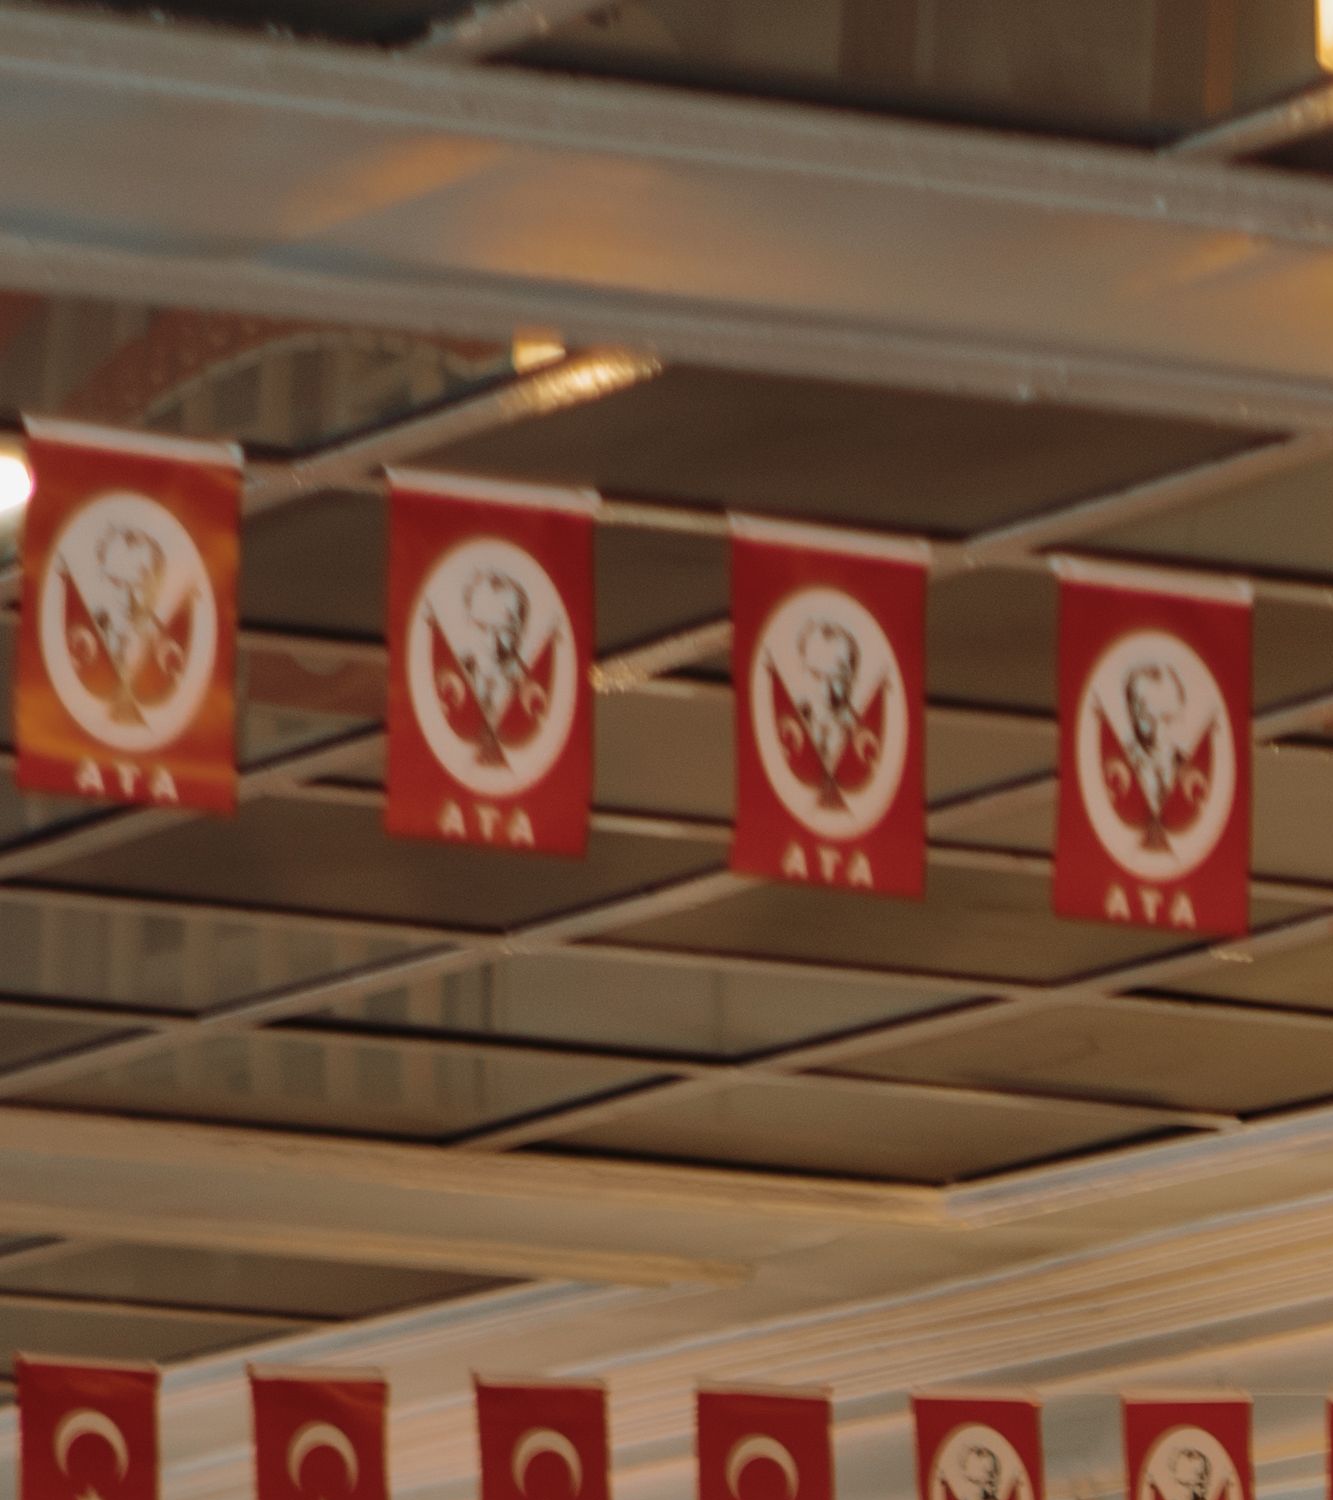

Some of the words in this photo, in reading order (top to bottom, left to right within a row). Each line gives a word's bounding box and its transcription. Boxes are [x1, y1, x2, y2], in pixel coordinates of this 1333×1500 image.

[75, 755, 179, 802] ATA
[437, 798, 534, 847] ATA
[782, 841, 874, 888] ATA
[1104, 882, 1196, 928] ATA
